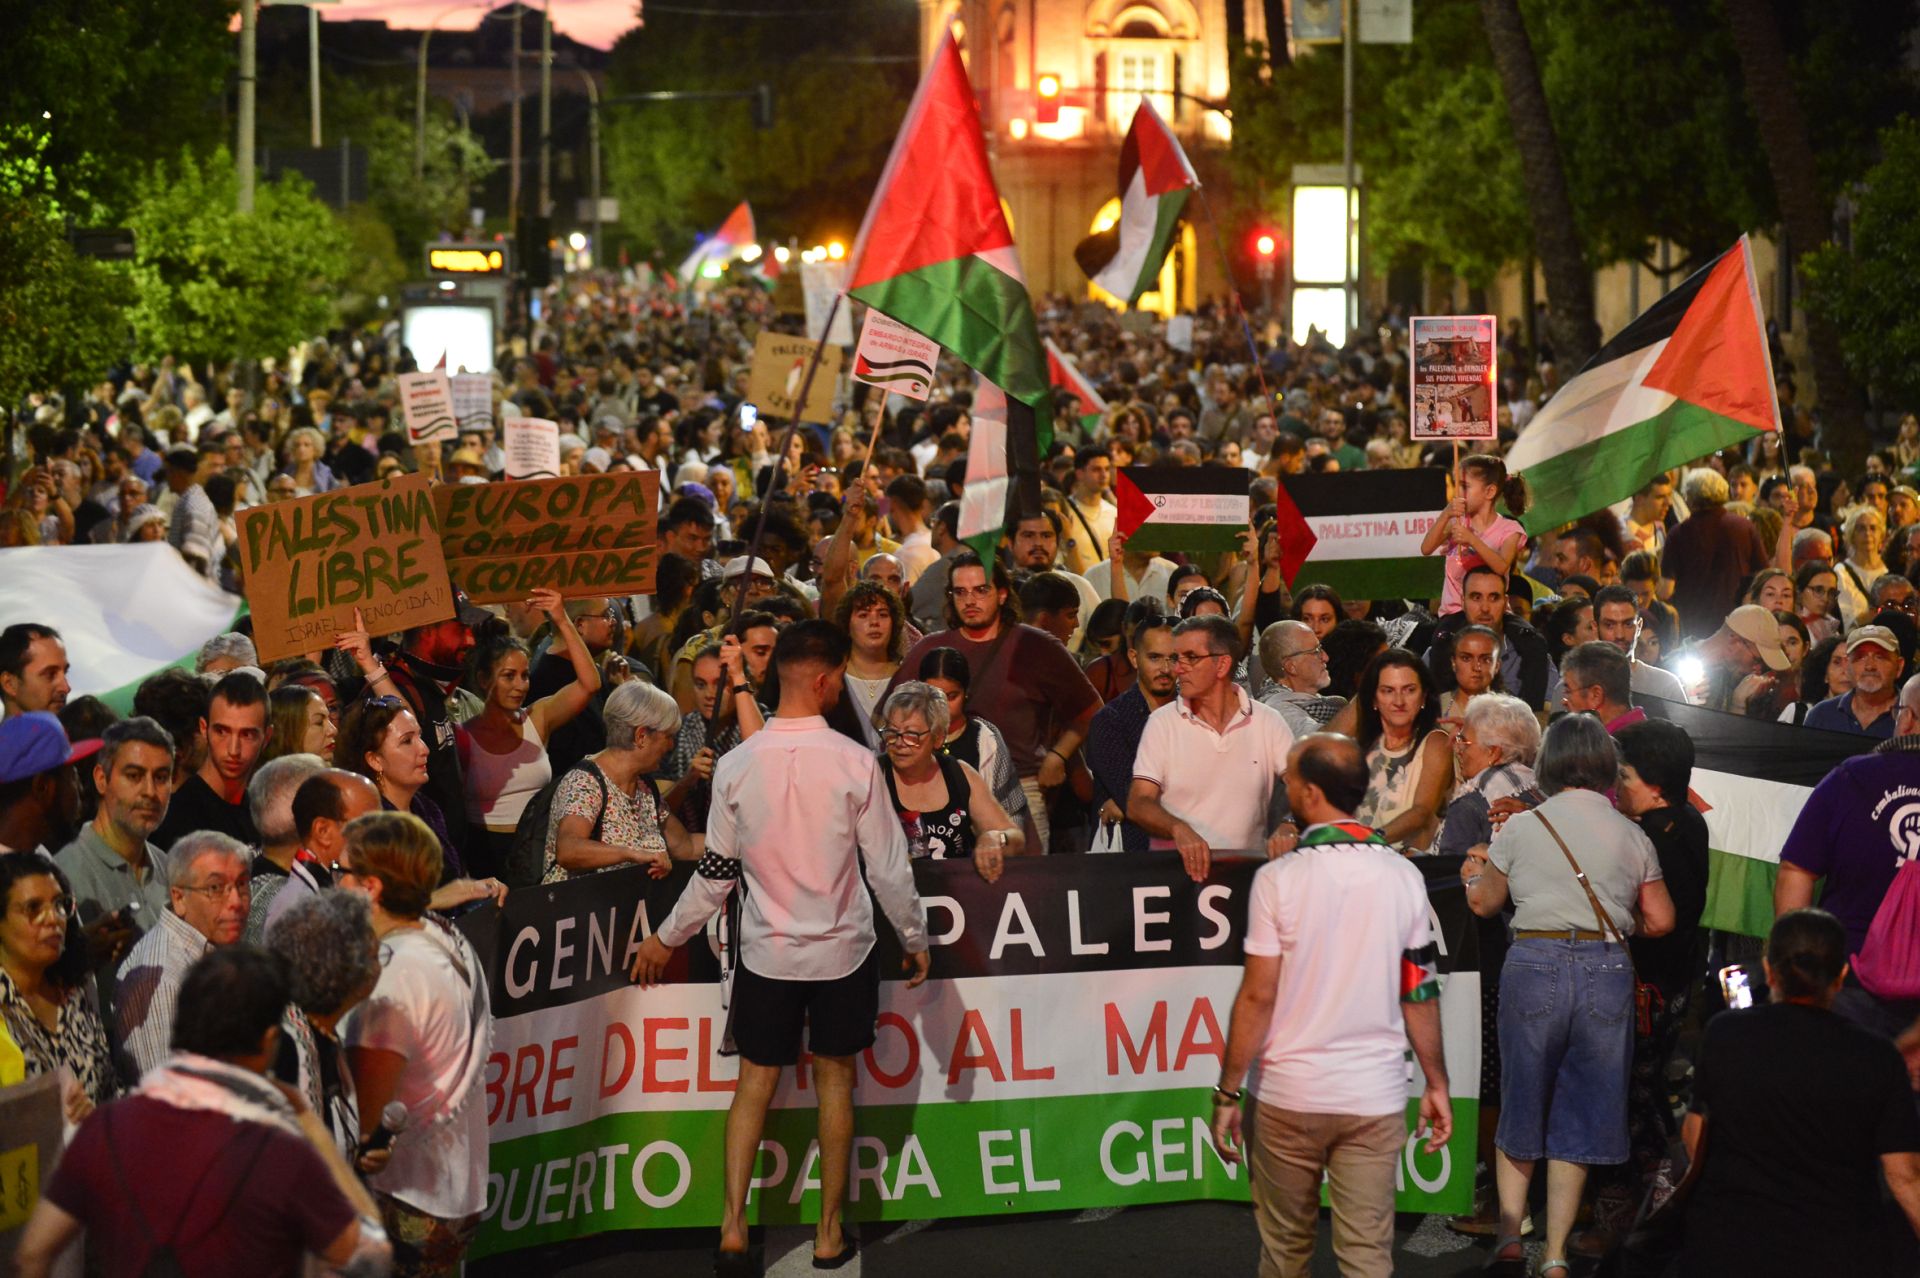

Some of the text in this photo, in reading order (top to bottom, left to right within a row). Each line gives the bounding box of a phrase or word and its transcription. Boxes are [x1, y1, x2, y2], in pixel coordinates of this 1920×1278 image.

[1429, 364, 1457, 373] PALESTINOS
[1436, 375, 1457, 383] PROPIAS
[1457, 374, 1482, 382] VIVIENDAS
[246, 479, 438, 574] PALESTINA
[445, 477, 646, 529] EUROPA
[1319, 517, 1435, 540] PALESTINA LIBR
[288, 539, 428, 619] LIBRE
[465, 549, 657, 595] COBARDE
[601, 1016, 738, 1101] DEL
[946, 1007, 1056, 1086] AL
[1103, 996, 1228, 1076] MA
[745, 1133, 942, 1206] PARA
[977, 1127, 1062, 1196] EL
